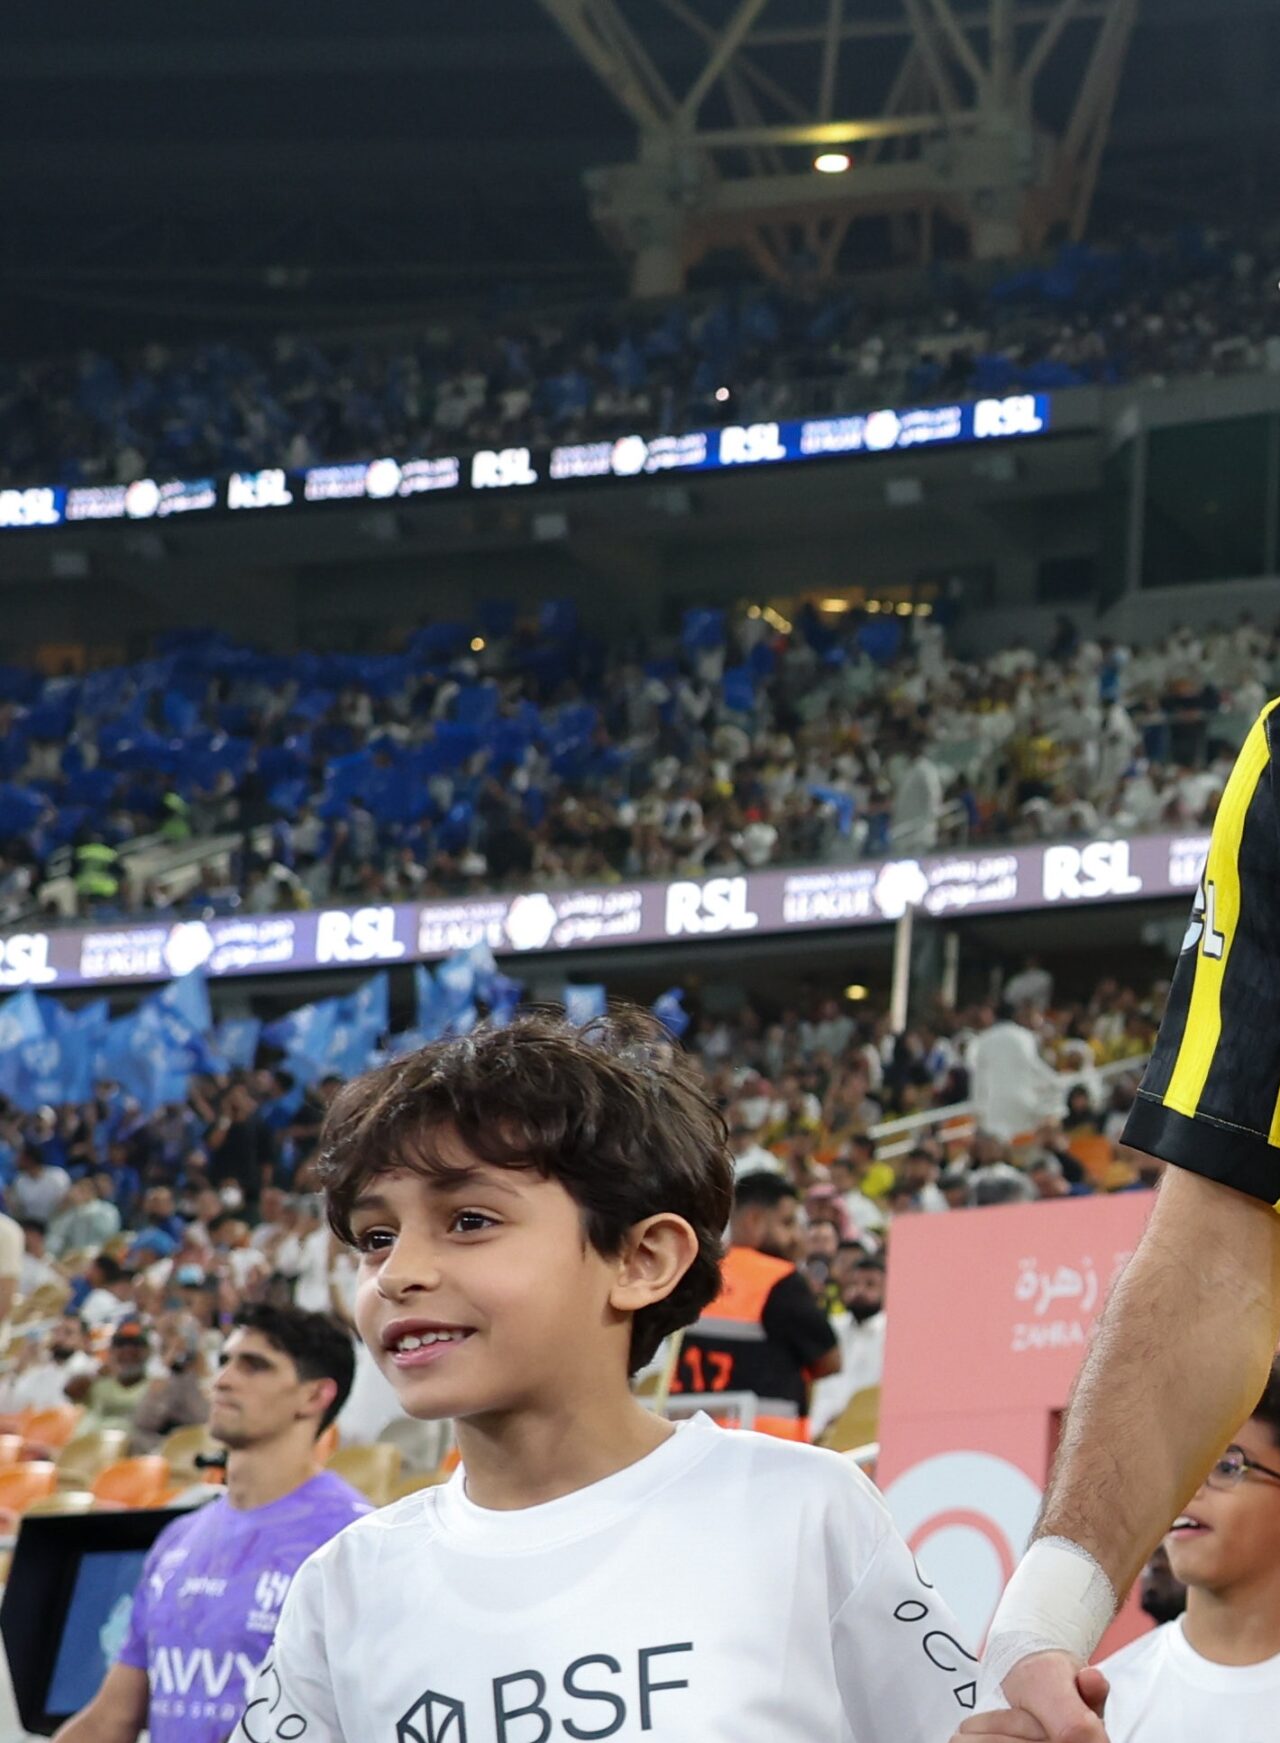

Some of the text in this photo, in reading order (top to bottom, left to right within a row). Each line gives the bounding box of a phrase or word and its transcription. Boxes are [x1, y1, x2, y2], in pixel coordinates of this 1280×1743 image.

[720, 424, 786, 463] RSL
[974, 396, 1042, 437] RSL
[472, 448, 537, 488] RSL
[1042, 840, 1143, 901] RSL
[665, 877, 759, 935] RSL
[0, 934, 58, 986] SL
[315, 907, 406, 963] RSL
[1015, 1254, 1099, 1316] زهرة
[148, 1647, 263, 1698] AVVY
[493, 1641, 694, 1743] BSF
